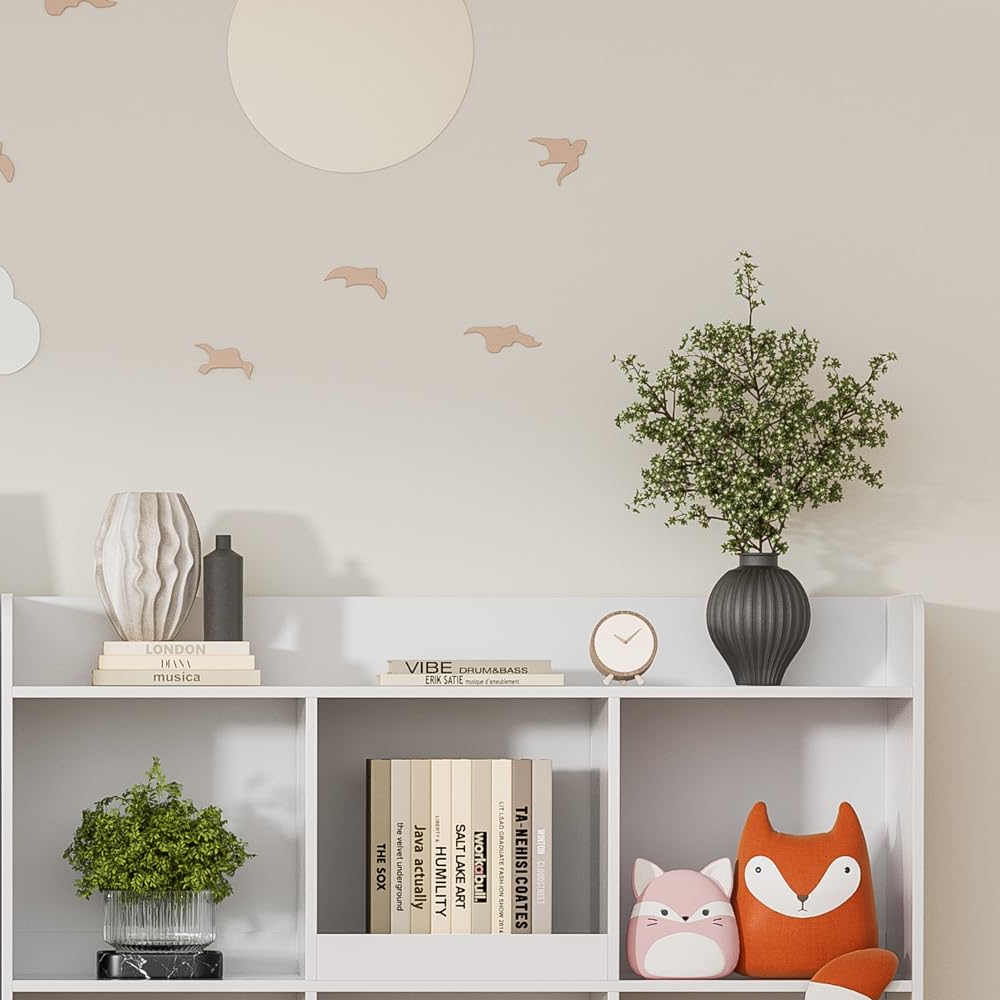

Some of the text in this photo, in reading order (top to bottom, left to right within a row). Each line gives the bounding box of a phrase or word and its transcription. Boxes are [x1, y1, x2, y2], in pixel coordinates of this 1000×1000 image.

[146, 644, 206, 655] LONDON
[161, 659, 191, 668] DIANA
[405, 661, 452, 674] VIBE
[153, 672, 201, 682] musica
[426, 676, 442, 685] ERIK
[444, 676, 464, 685] SATIE
[376, 844, 386, 891] THE SOX
[395, 862, 404, 912] underground
[411, 824, 427, 910] Java actually
[435, 846, 447, 917] HUMILITY
[455, 824, 466, 909] SALT LAKE ART
[515, 806, 528, 929] TA-NEHISI COATES
